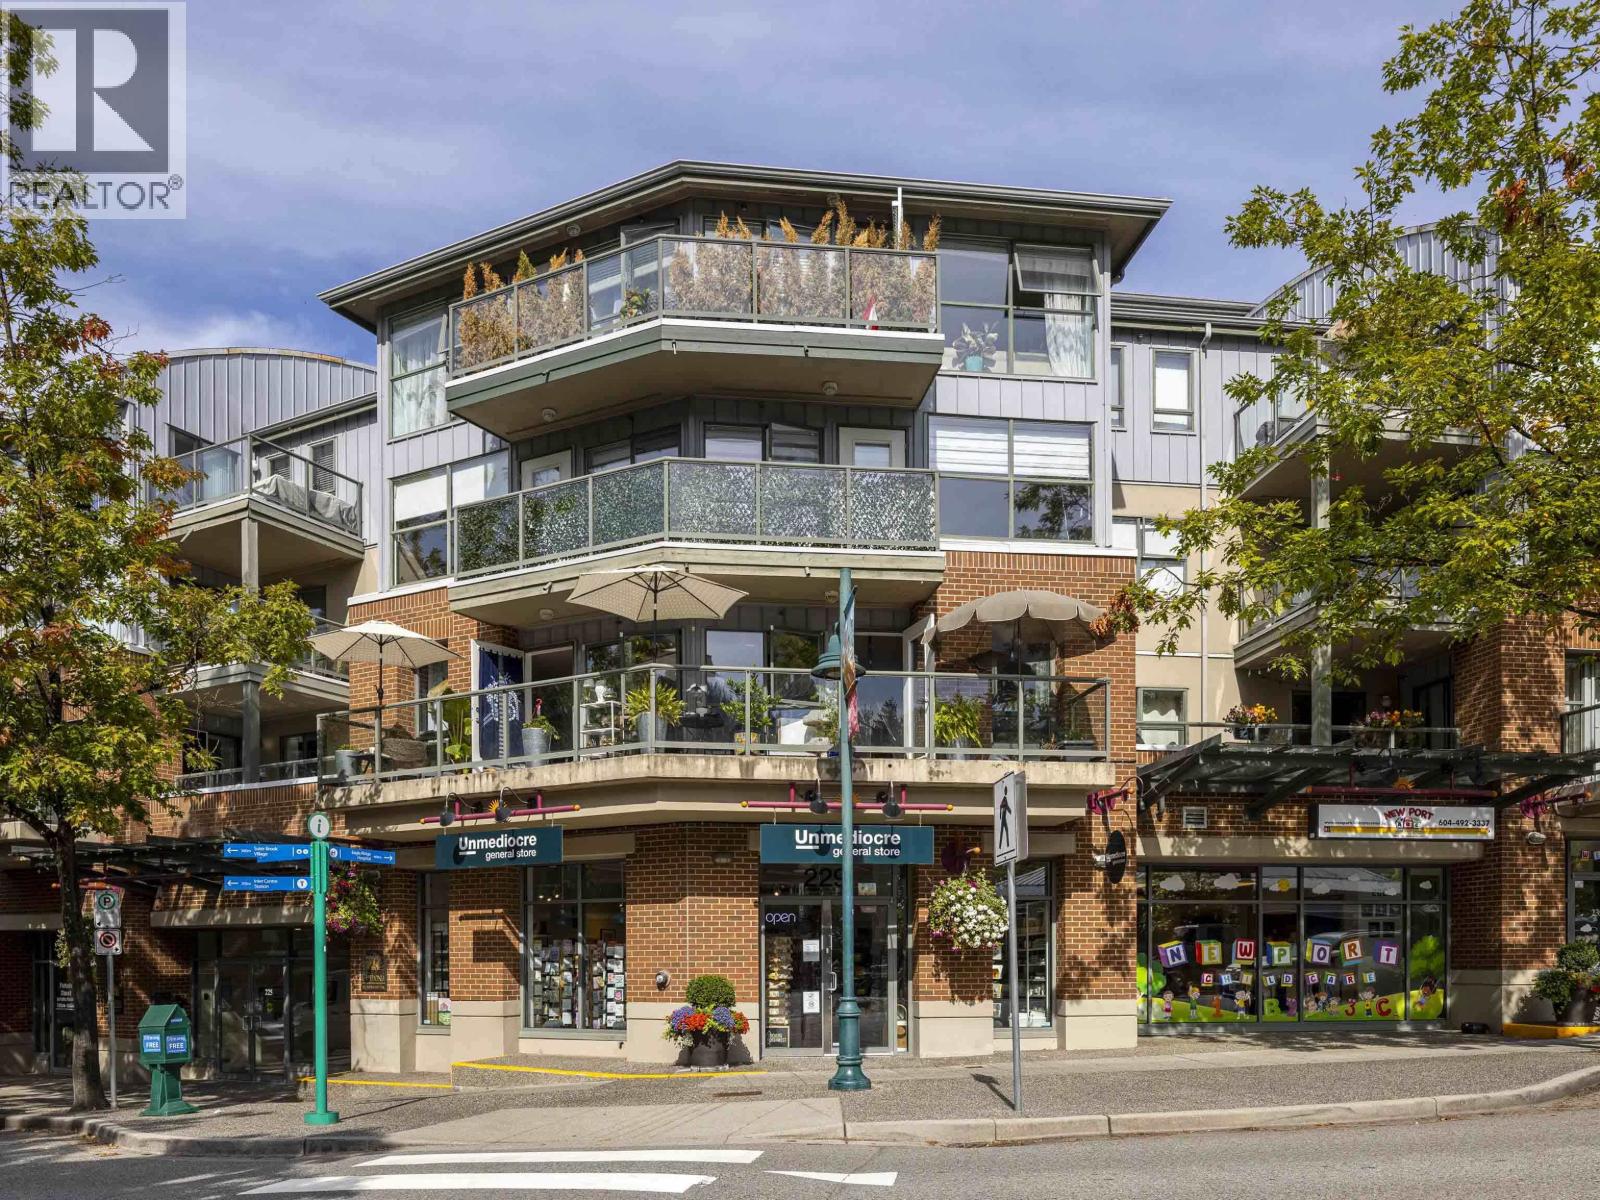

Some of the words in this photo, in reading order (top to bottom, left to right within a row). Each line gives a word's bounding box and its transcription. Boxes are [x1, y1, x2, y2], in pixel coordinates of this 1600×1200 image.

[1384, 807, 1406, 820] NEW
[1408, 807, 1434, 820] PORT
[1438, 819, 1490, 827] 604-492-3337
[458, 833, 537, 851] Unmediocre
[485, 850, 515, 862] general
[516, 848, 537, 858] store
[833, 847, 872, 858] geeral
[874, 847, 901, 856] store
[765, 912, 797, 925] open
[145, 1041, 159, 1049] FREE
